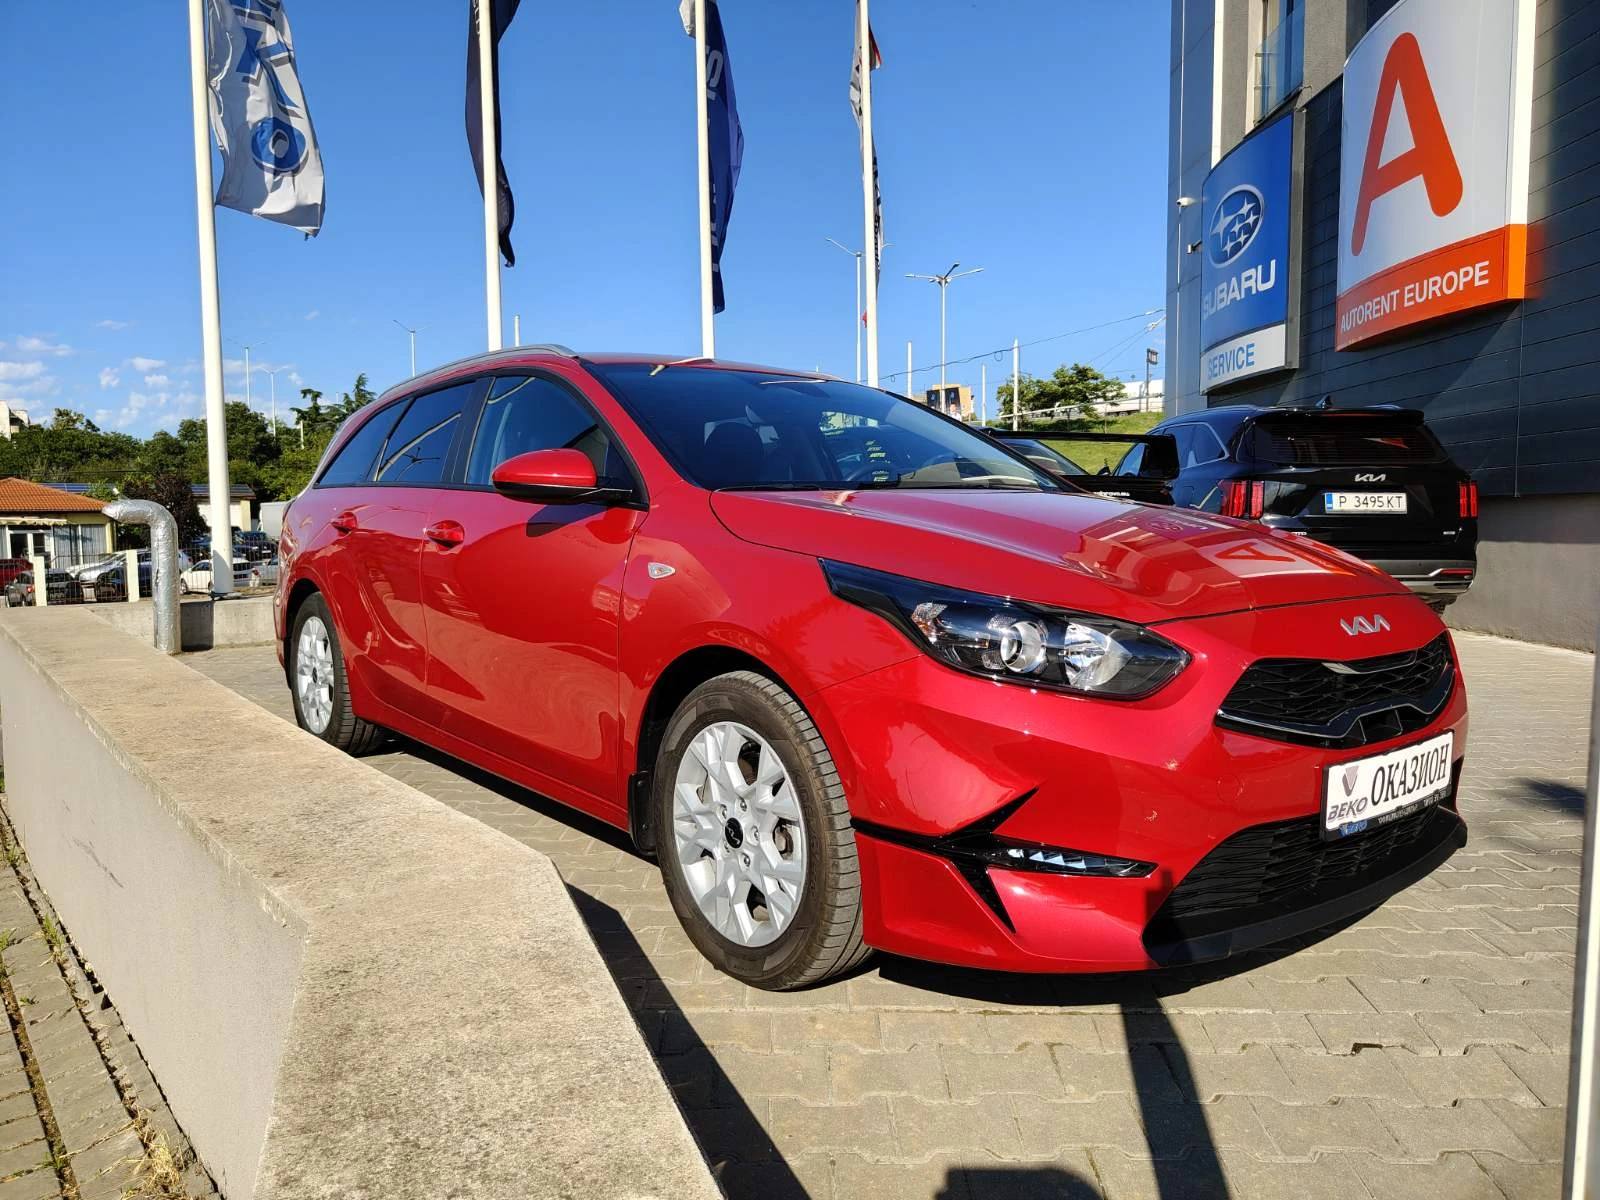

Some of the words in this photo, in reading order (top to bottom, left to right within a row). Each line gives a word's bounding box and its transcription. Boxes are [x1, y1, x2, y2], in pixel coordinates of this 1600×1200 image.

[1351, 31, 1463, 257] A
[1202, 258, 1276, 320] SUBARU
[1340, 288, 1399, 335] AUTORENT
[1403, 260, 1490, 308] EUROPE
[1207, 342, 1256, 380] SERVICE
[1353, 495, 1385, 508] 3495
[1371, 743, 1449, 806] ОКАЗИОН
